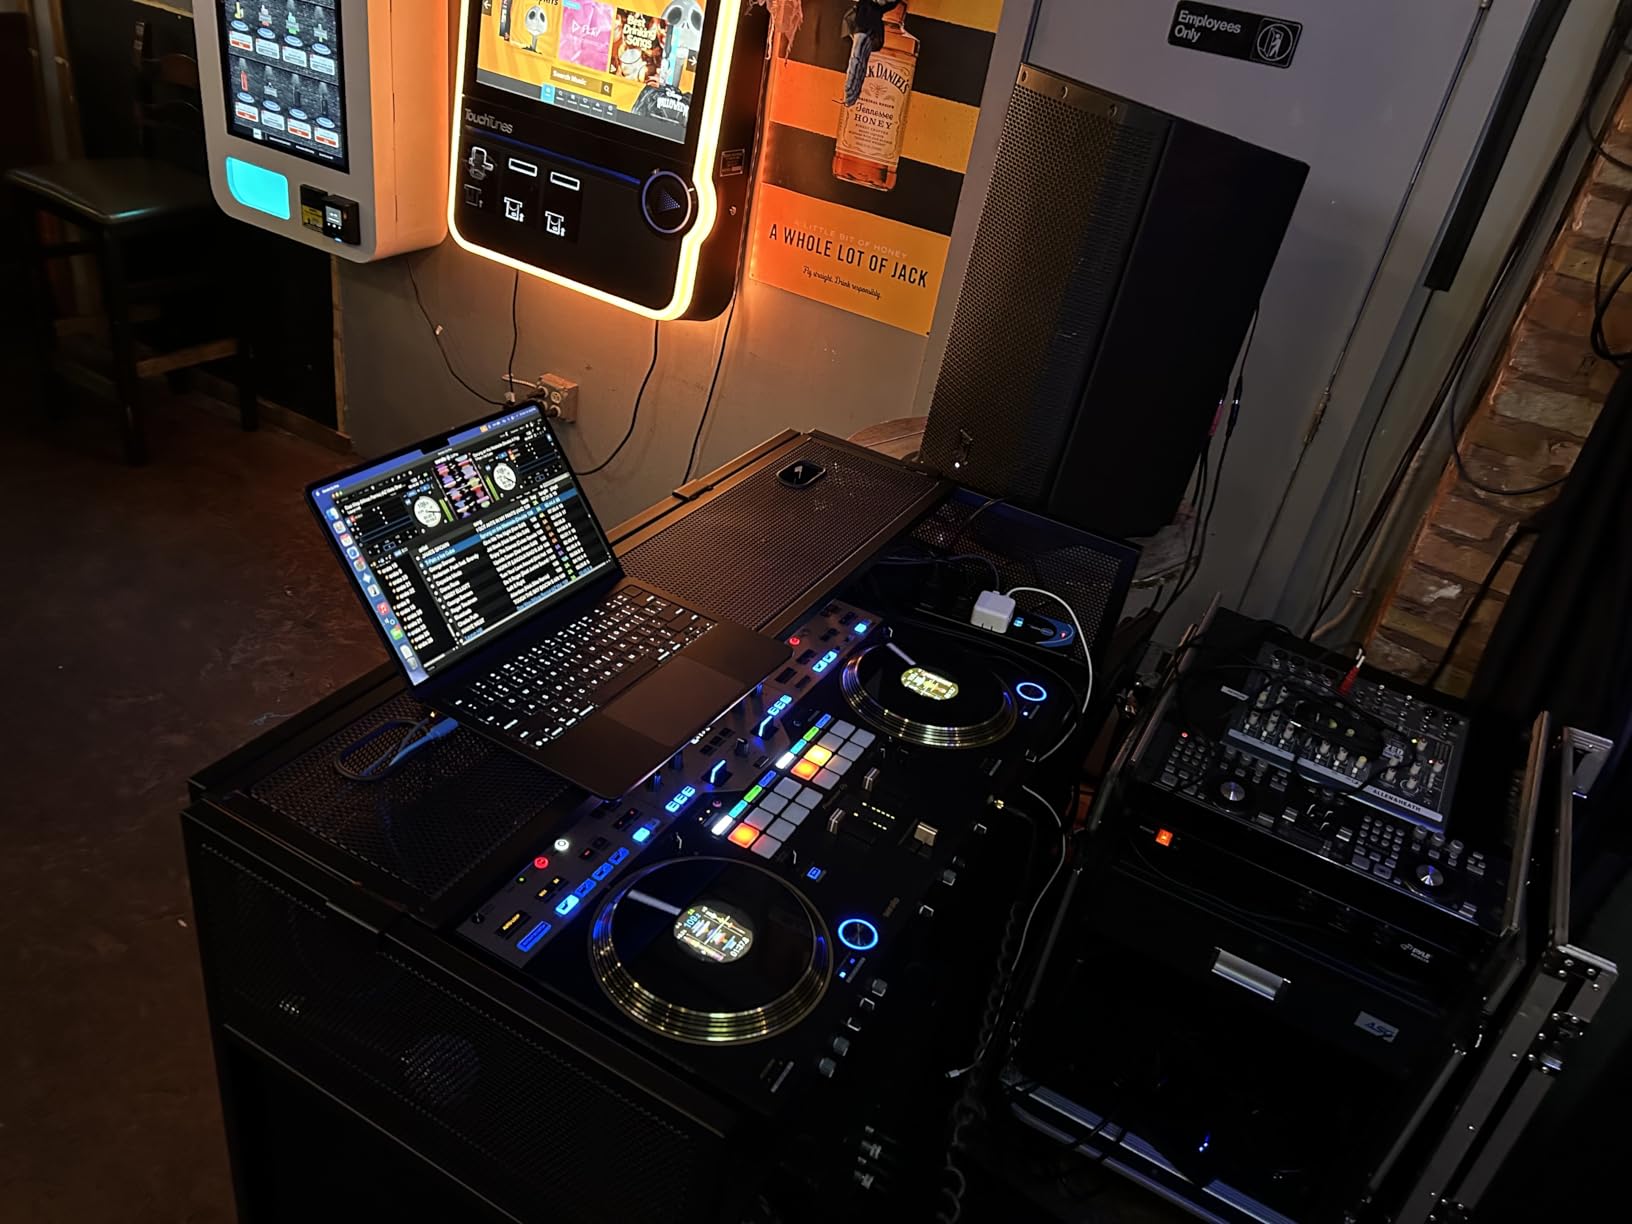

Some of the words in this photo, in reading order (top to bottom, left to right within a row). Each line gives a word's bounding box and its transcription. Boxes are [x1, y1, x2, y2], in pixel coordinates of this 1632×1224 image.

[627, 15, 645, 28] Best
[1178, 10, 1241, 34] Employees
[623, 24, 657, 41] Drinking
[627, 34, 653, 50] Songs
[1174, 25, 1201, 42] Only
[876, 62, 910, 94] DANIEL'S
[464, 107, 513, 134] TouchTunes
[854, 113, 892, 129] HONEY
[856, 101, 893, 121] Tennessee
[803, 223, 835, 237] LITTLE
[839, 233, 855, 243] BIT
[857, 239, 870, 248] OF
[873, 244, 908, 259] HONEY
[769, 223, 778, 240] A
[783, 226, 833, 257] WHOLE
[837, 244, 864, 268] LOT
[868, 254, 888, 274] OF
[890, 261, 929, 288] JACK
[834, 275, 851, 289] Drink
[1372, 787, 1422, 812] ALLEN&HEATH
